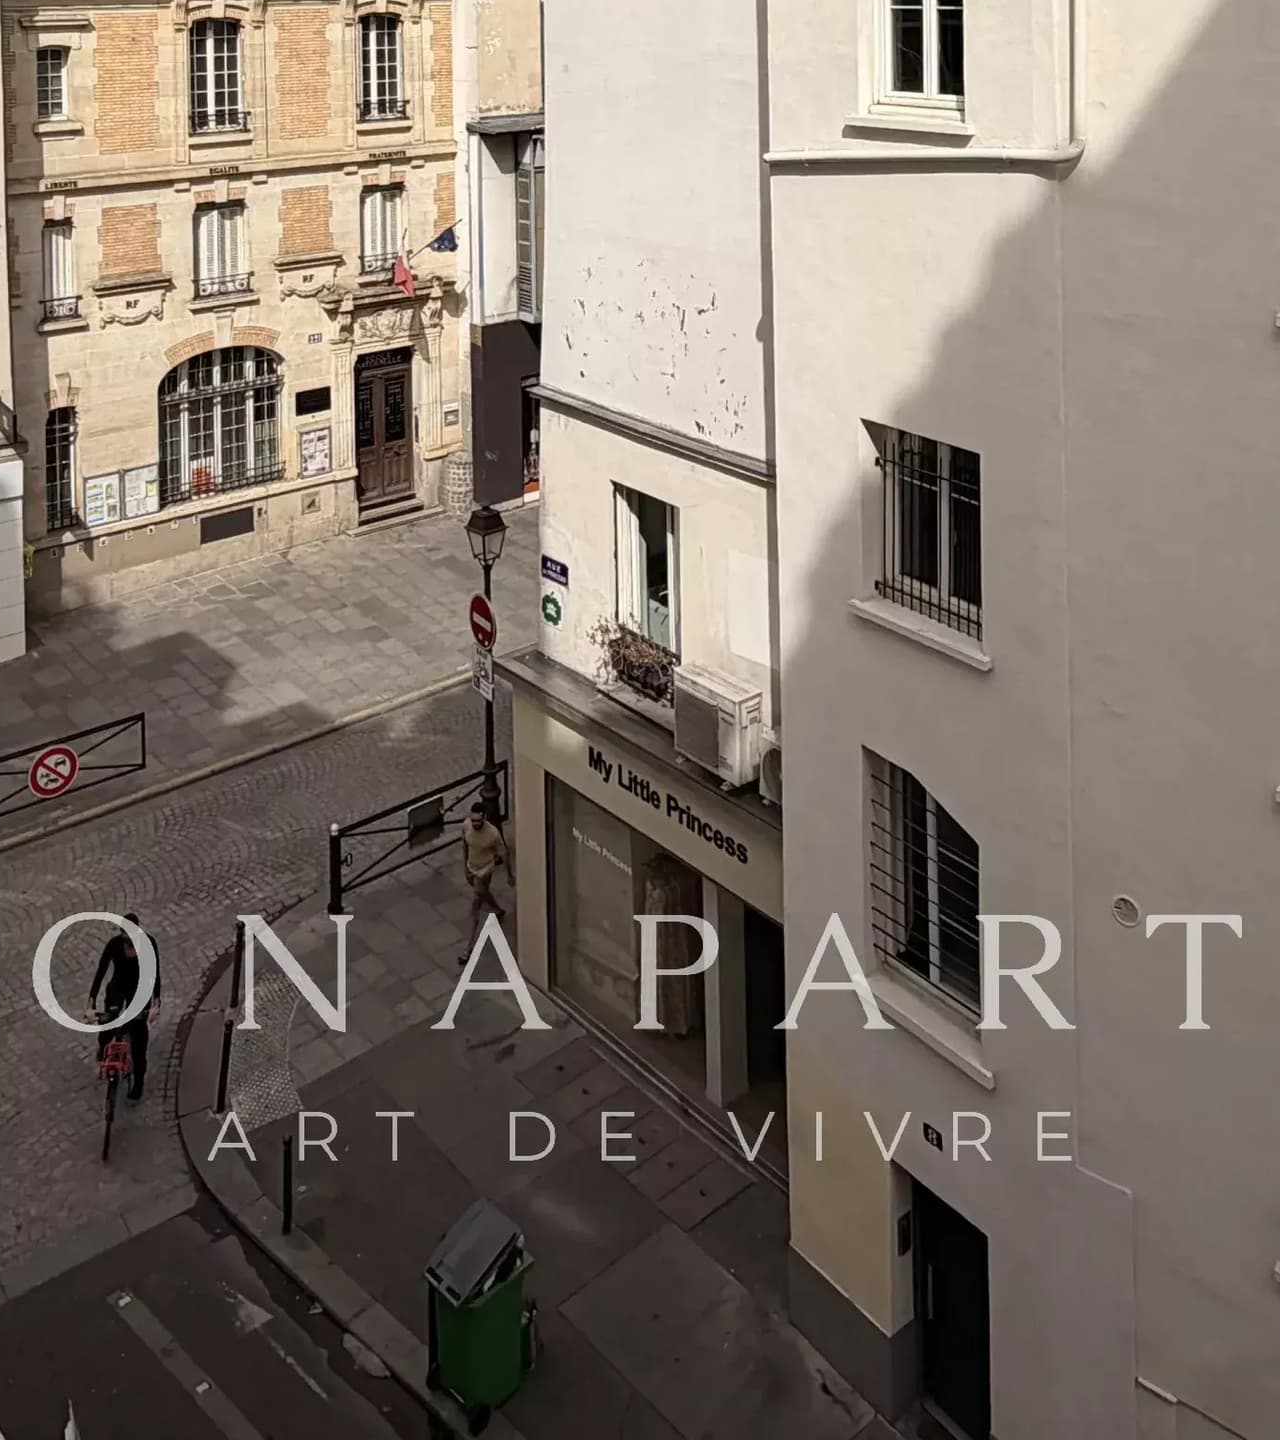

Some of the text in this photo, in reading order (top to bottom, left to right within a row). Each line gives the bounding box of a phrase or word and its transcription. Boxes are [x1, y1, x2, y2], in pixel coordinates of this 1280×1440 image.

[125, 299, 140, 310] RF
[588, 745, 748, 864] My Little Princess
